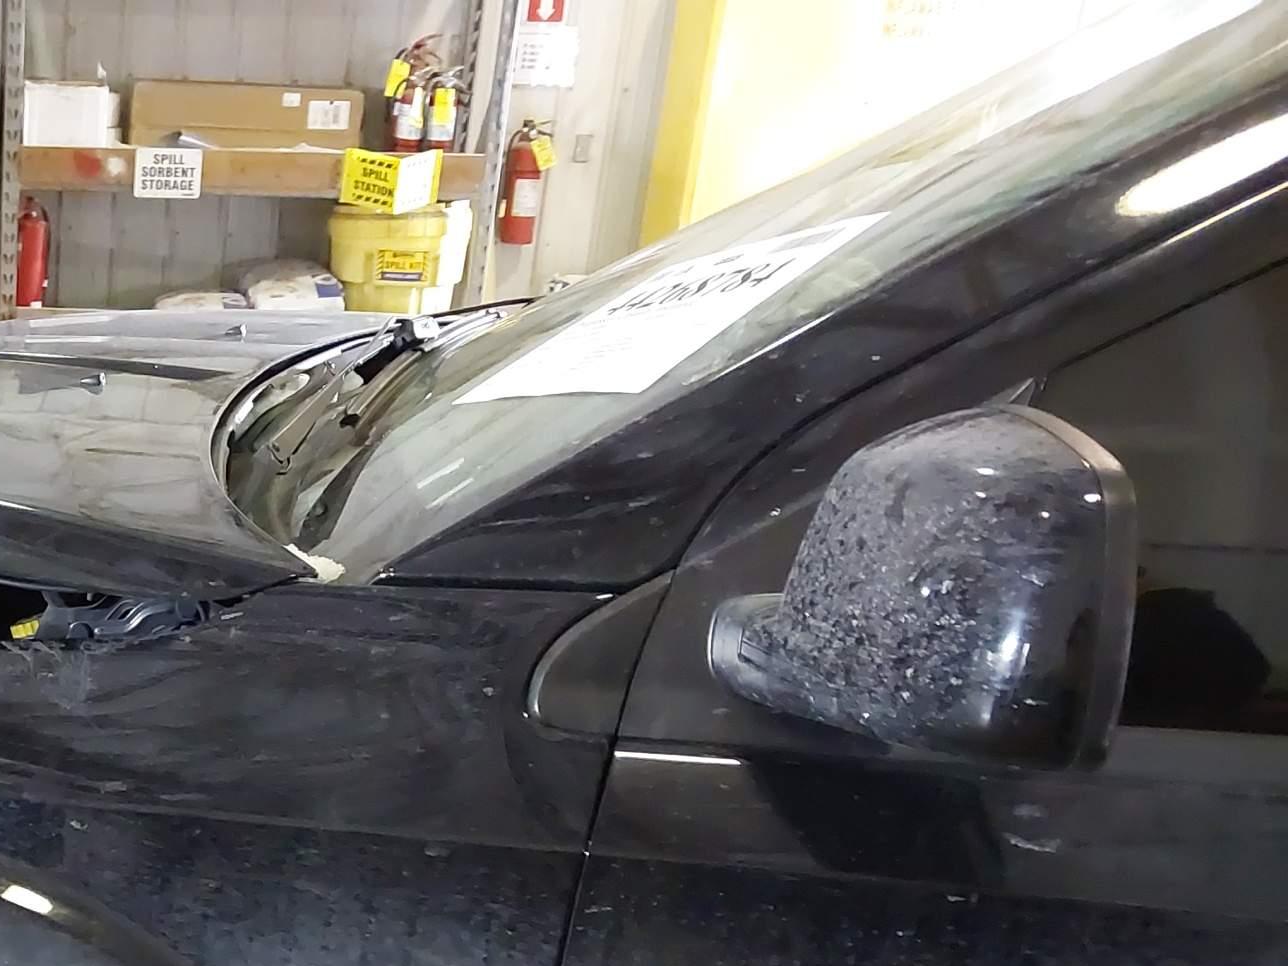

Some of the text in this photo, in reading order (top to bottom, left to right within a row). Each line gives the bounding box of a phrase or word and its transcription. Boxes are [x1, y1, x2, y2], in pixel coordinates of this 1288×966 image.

[153, 153, 184, 165] SPILL
[142, 166, 196, 178] SORBENT
[362, 167, 389, 182] SPILL
[141, 179, 195, 191] STORAGE
[353, 180, 394, 198] STATION
